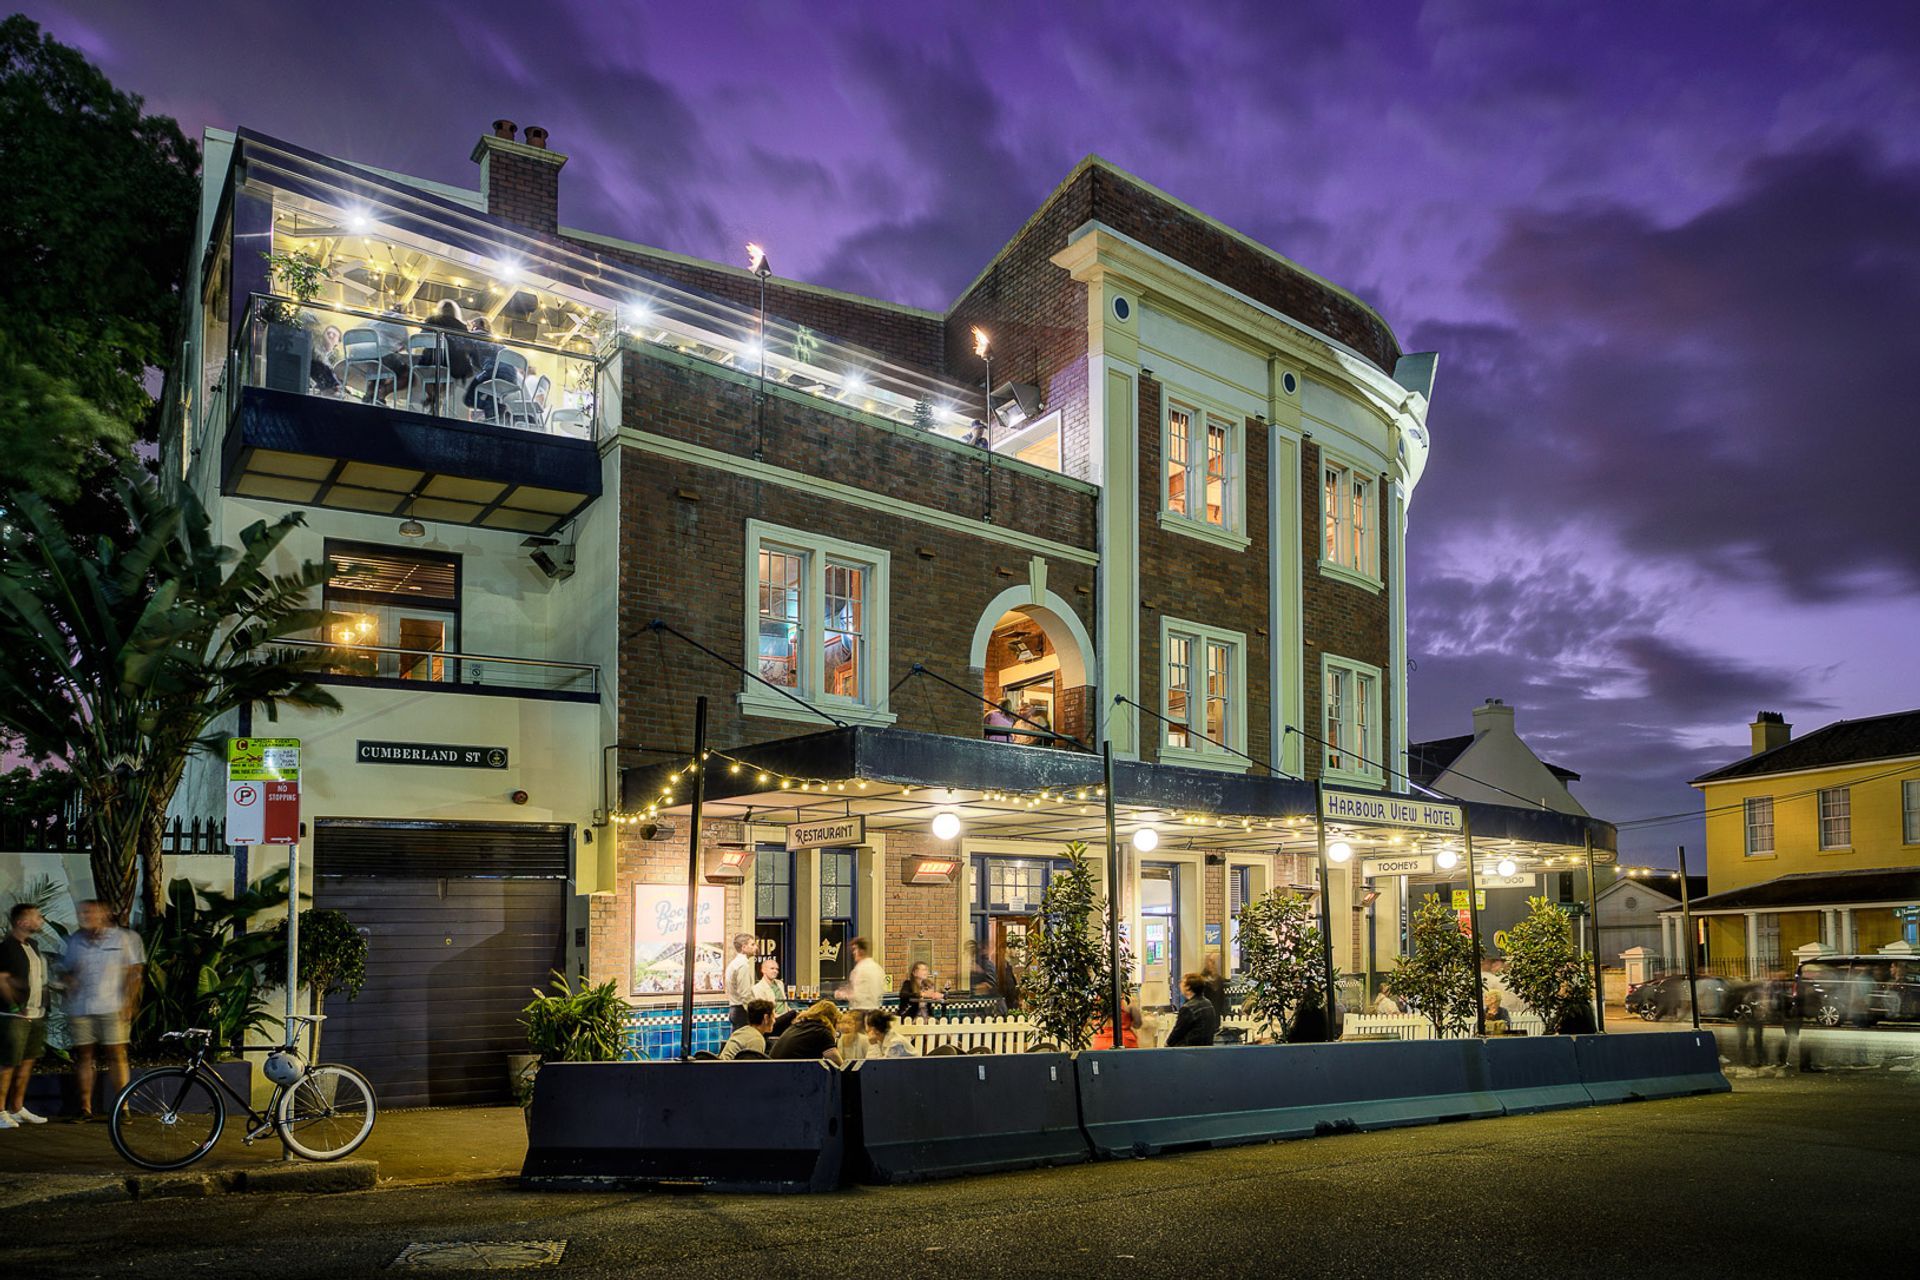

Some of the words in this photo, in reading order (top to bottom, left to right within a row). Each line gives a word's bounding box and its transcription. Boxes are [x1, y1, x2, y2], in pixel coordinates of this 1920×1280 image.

[361, 746, 457, 761] CUMBERLAND
[465, 752, 481, 763] ST
[241, 790, 251, 802] P
[268, 793, 296, 801] STOPPING
[1328, 795, 1386, 819] HARBOUR
[1390, 803, 1418, 822] VIEW
[1423, 806, 1456, 826] HOTEL
[795, 824, 854, 845] RESTAURANT
[1377, 860, 1419, 872] TOOHEYS
[1502, 876, 1524, 884] OOD
[655, 900, 711, 920] Roop
[656, 915, 711, 936] Terce
